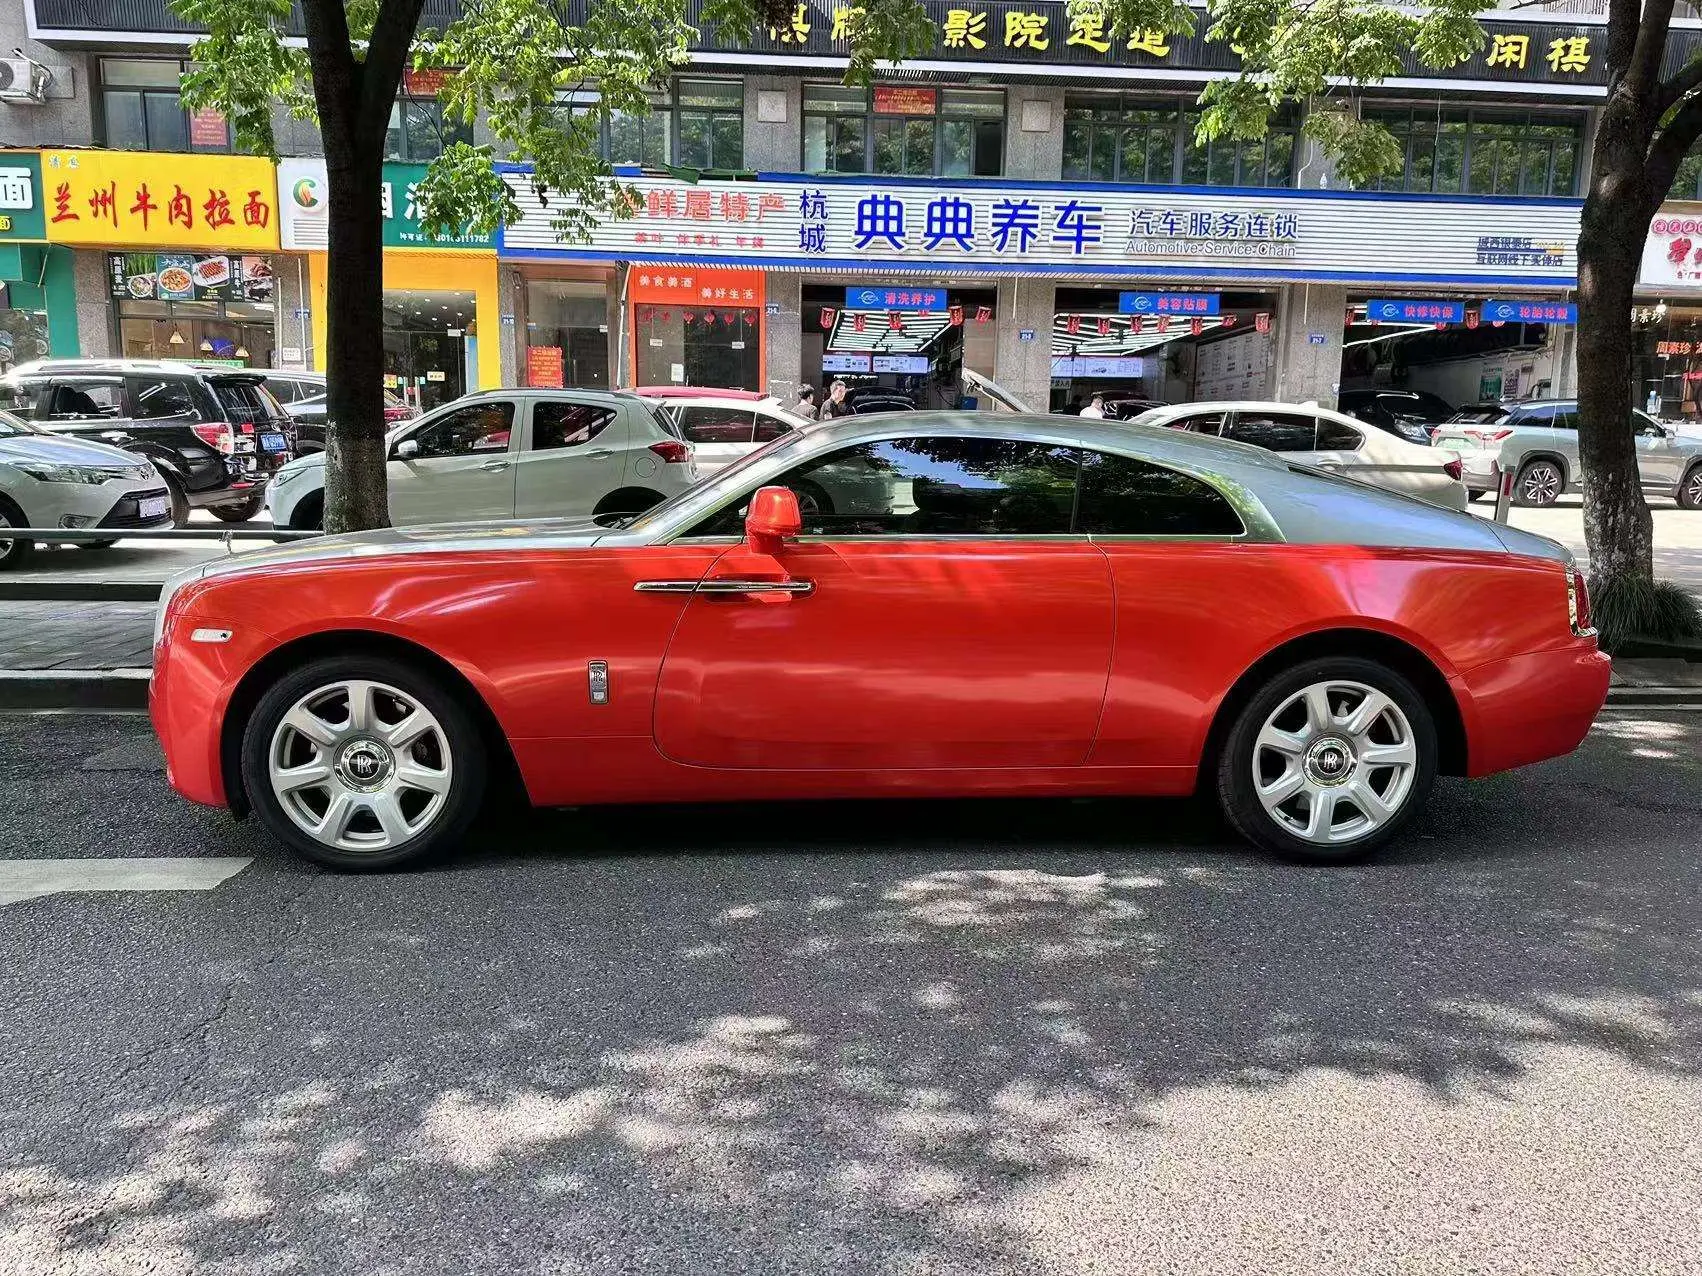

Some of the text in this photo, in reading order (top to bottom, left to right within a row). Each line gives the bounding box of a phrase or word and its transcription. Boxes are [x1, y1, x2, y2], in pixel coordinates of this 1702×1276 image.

[51, 181, 270, 232] 兰州牛肉拉面
[799, 189, 829, 253] 杭城
[855, 194, 1104, 255] 典典养车
[1129, 210, 1299, 239] 汽车服务连锁
[1126, 240, 1296, 257] Automotive Service Chain
[639, 274, 693, 288] 美食美酒
[701, 287, 756, 300] 美好生活
[884, 291, 936, 306] 清洗养护
